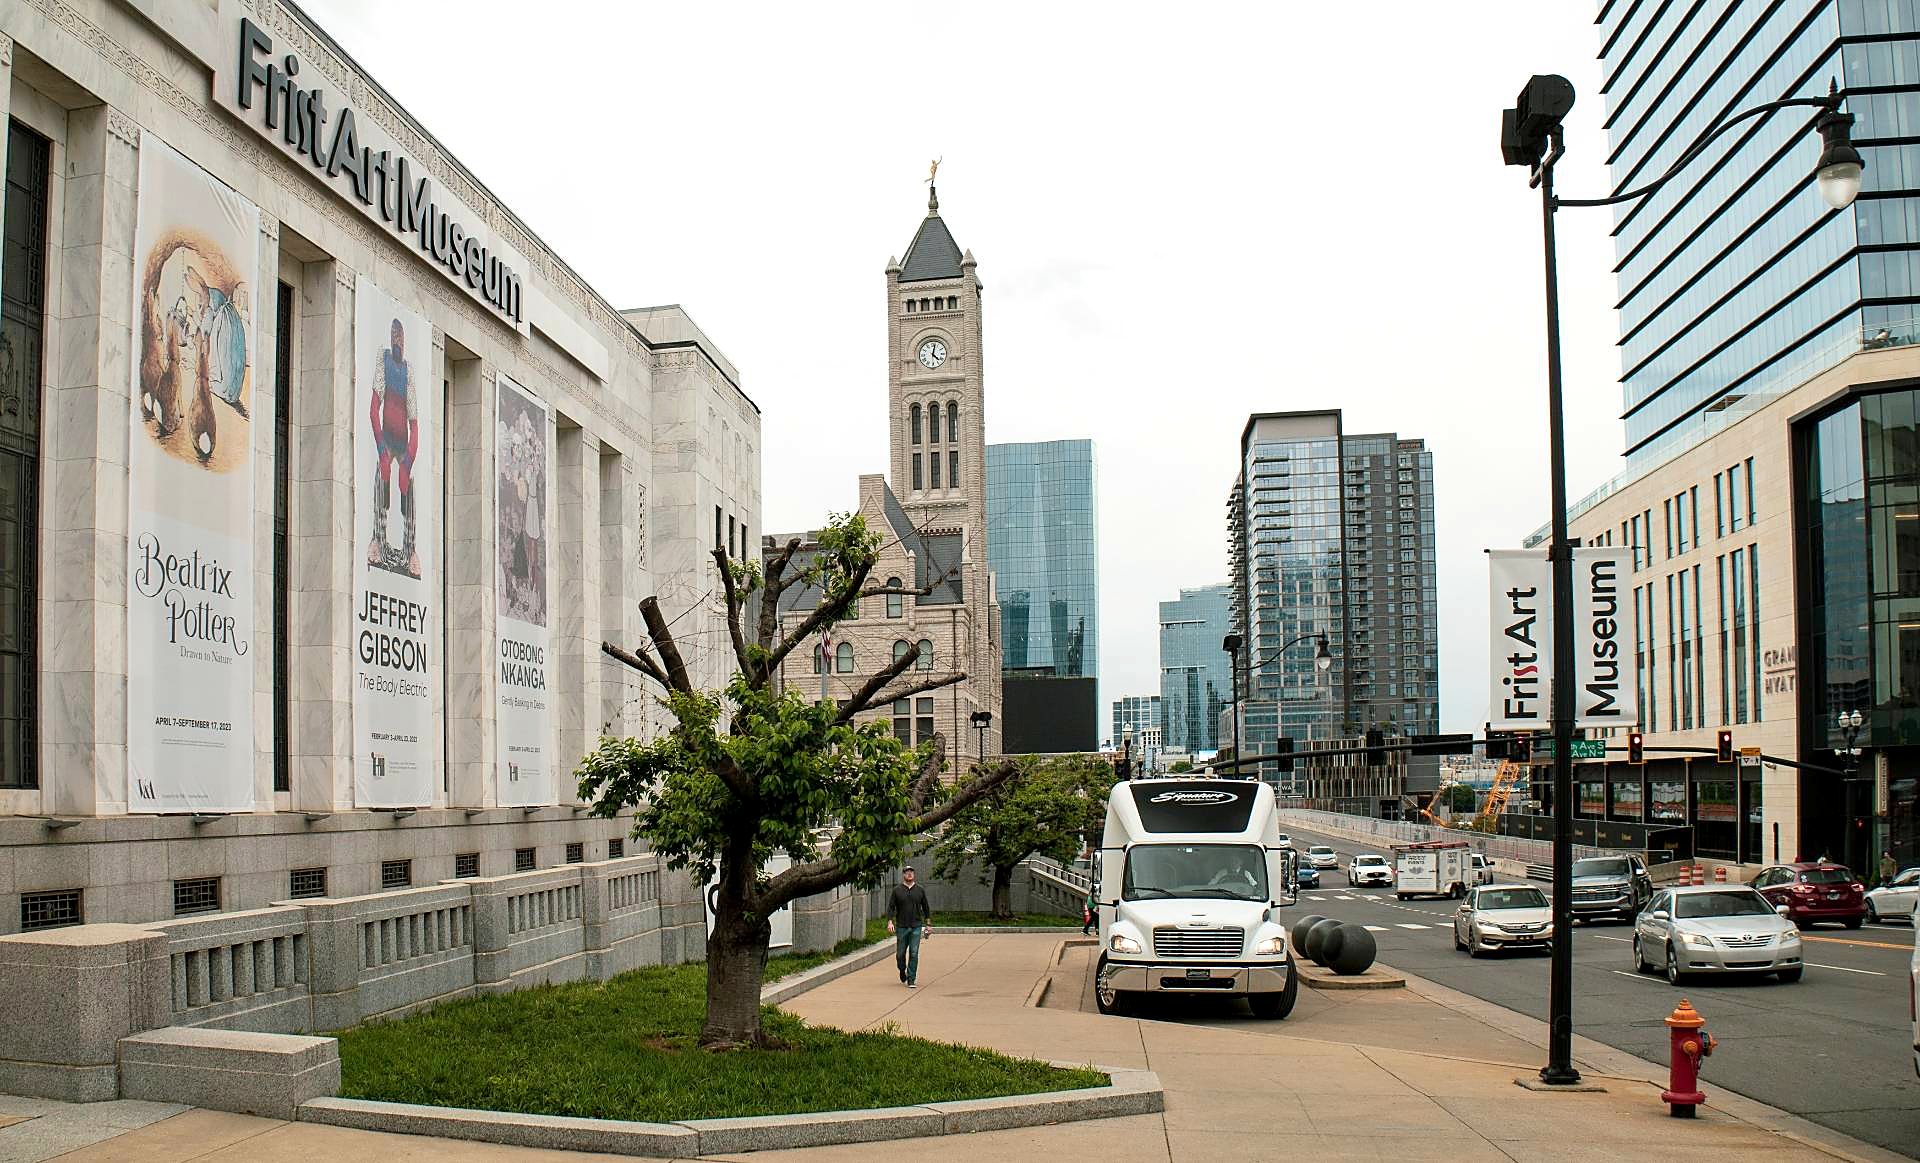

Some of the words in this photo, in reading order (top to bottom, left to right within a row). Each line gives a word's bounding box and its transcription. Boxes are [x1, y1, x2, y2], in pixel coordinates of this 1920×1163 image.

[238, 17, 327, 168] Frist
[327, 107, 397, 221] Art
[398, 156, 523, 324] Museum
[136, 532, 235, 599] Beatrix
[164, 589, 248, 656] Potter
[359, 590, 427, 634] JEFFREY
[1504, 587, 1537, 648] Art
[359, 630, 427, 673] GIBSON
[501, 638, 544, 664] OTOBONG
[1585, 561, 1620, 716] Museum
[180, 645, 203, 660] Drawn
[204, 650, 211, 661] to
[212, 651, 233, 665] Nature
[1764, 645, 1796, 667] GRAN
[359, 672, 375, 690] The
[376, 676, 398, 697] Body
[400, 680, 428, 698] Electric
[501, 661, 546, 690] NKANGA
[1503, 653, 1538, 719] Frist
[1765, 675, 1795, 695] HYAT
[155, 717, 172, 726] APRIL
[211, 721, 219, 731] 17,
[219, 722, 232, 731] 2023
[1571, 749, 1588, 758] Ave
[1589, 749, 1597, 758] N
[1579, 741, 1595, 750] Ave
[1597, 741, 1604, 750] S
[1150, 792, 1225, 803] Signature
